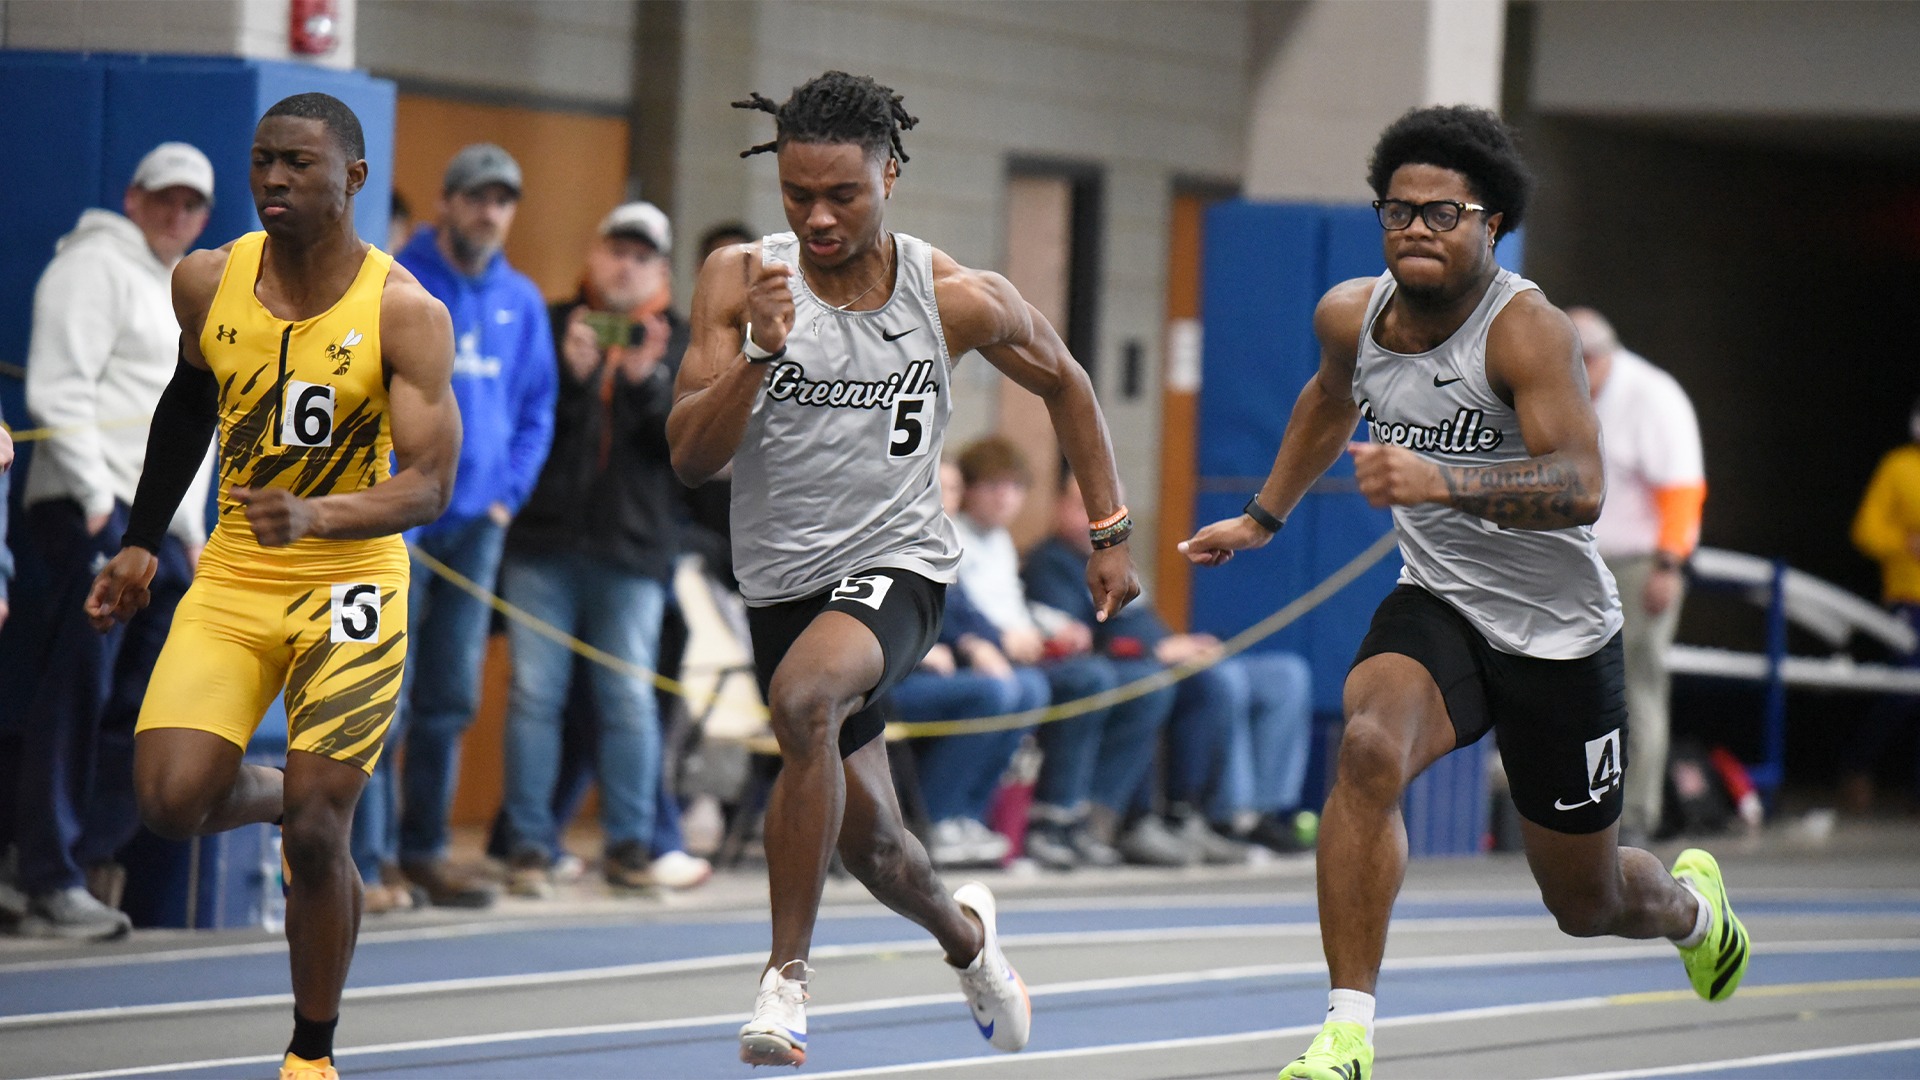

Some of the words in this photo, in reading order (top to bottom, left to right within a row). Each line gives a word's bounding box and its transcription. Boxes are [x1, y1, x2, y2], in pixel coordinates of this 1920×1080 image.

[294, 386, 331, 445] 6
[890, 400, 922, 457] 5
[1463, 463, 1567, 492] Pamela
[341, 584, 378, 640] 6
[835, 577, 874, 600] 5
[1590, 738, 1619, 793] 4
